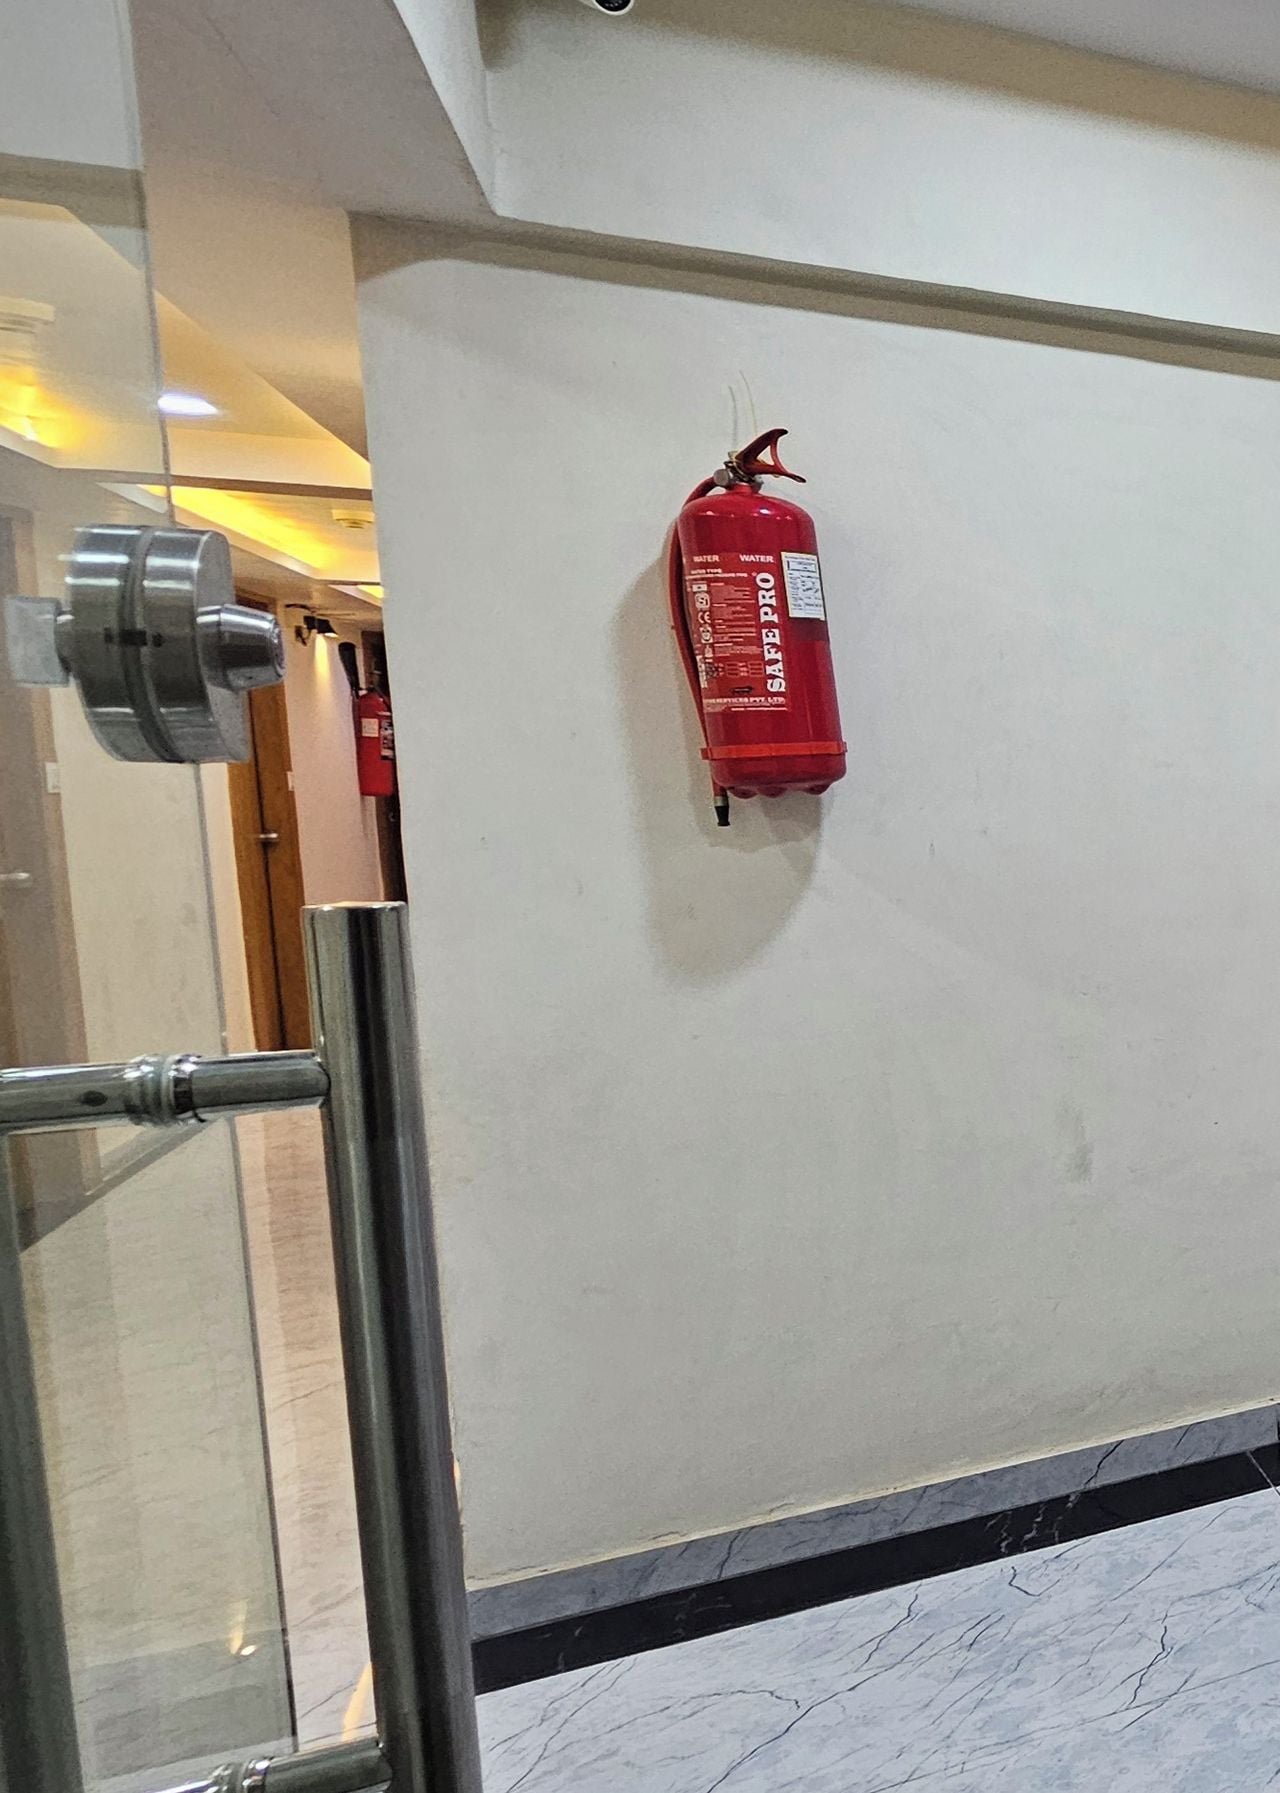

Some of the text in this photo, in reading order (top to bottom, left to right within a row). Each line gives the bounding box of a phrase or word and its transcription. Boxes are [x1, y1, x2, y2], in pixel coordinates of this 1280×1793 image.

[739, 554, 774, 563] WATER
[755, 572, 786, 692] SAFE PRO
